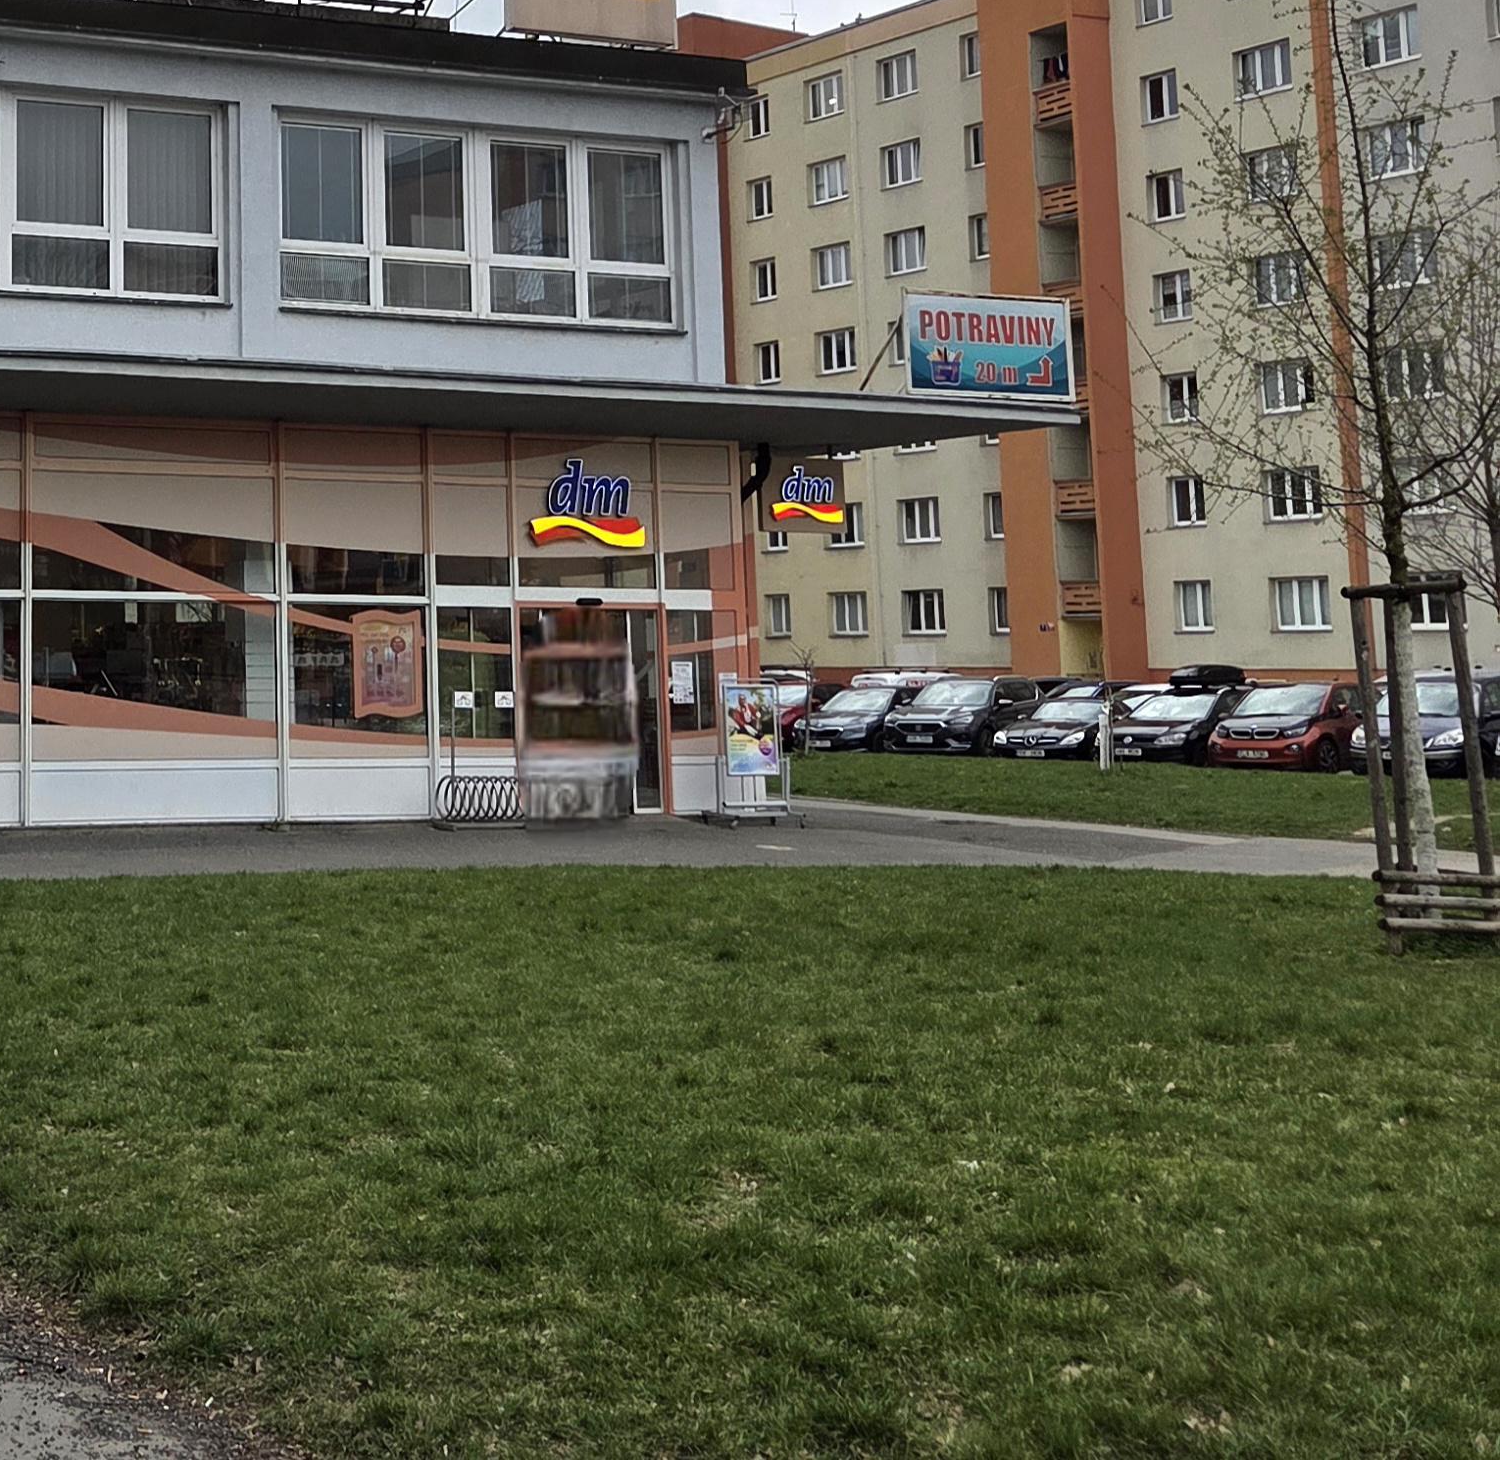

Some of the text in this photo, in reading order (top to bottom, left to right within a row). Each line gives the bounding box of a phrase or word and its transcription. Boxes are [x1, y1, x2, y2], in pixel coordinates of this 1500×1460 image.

[919, 309, 1055, 347] POTRAVINY
[975, 361, 1018, 384] 20 m
[548, 458, 632, 516] dm
[782, 465, 834, 503] dm
